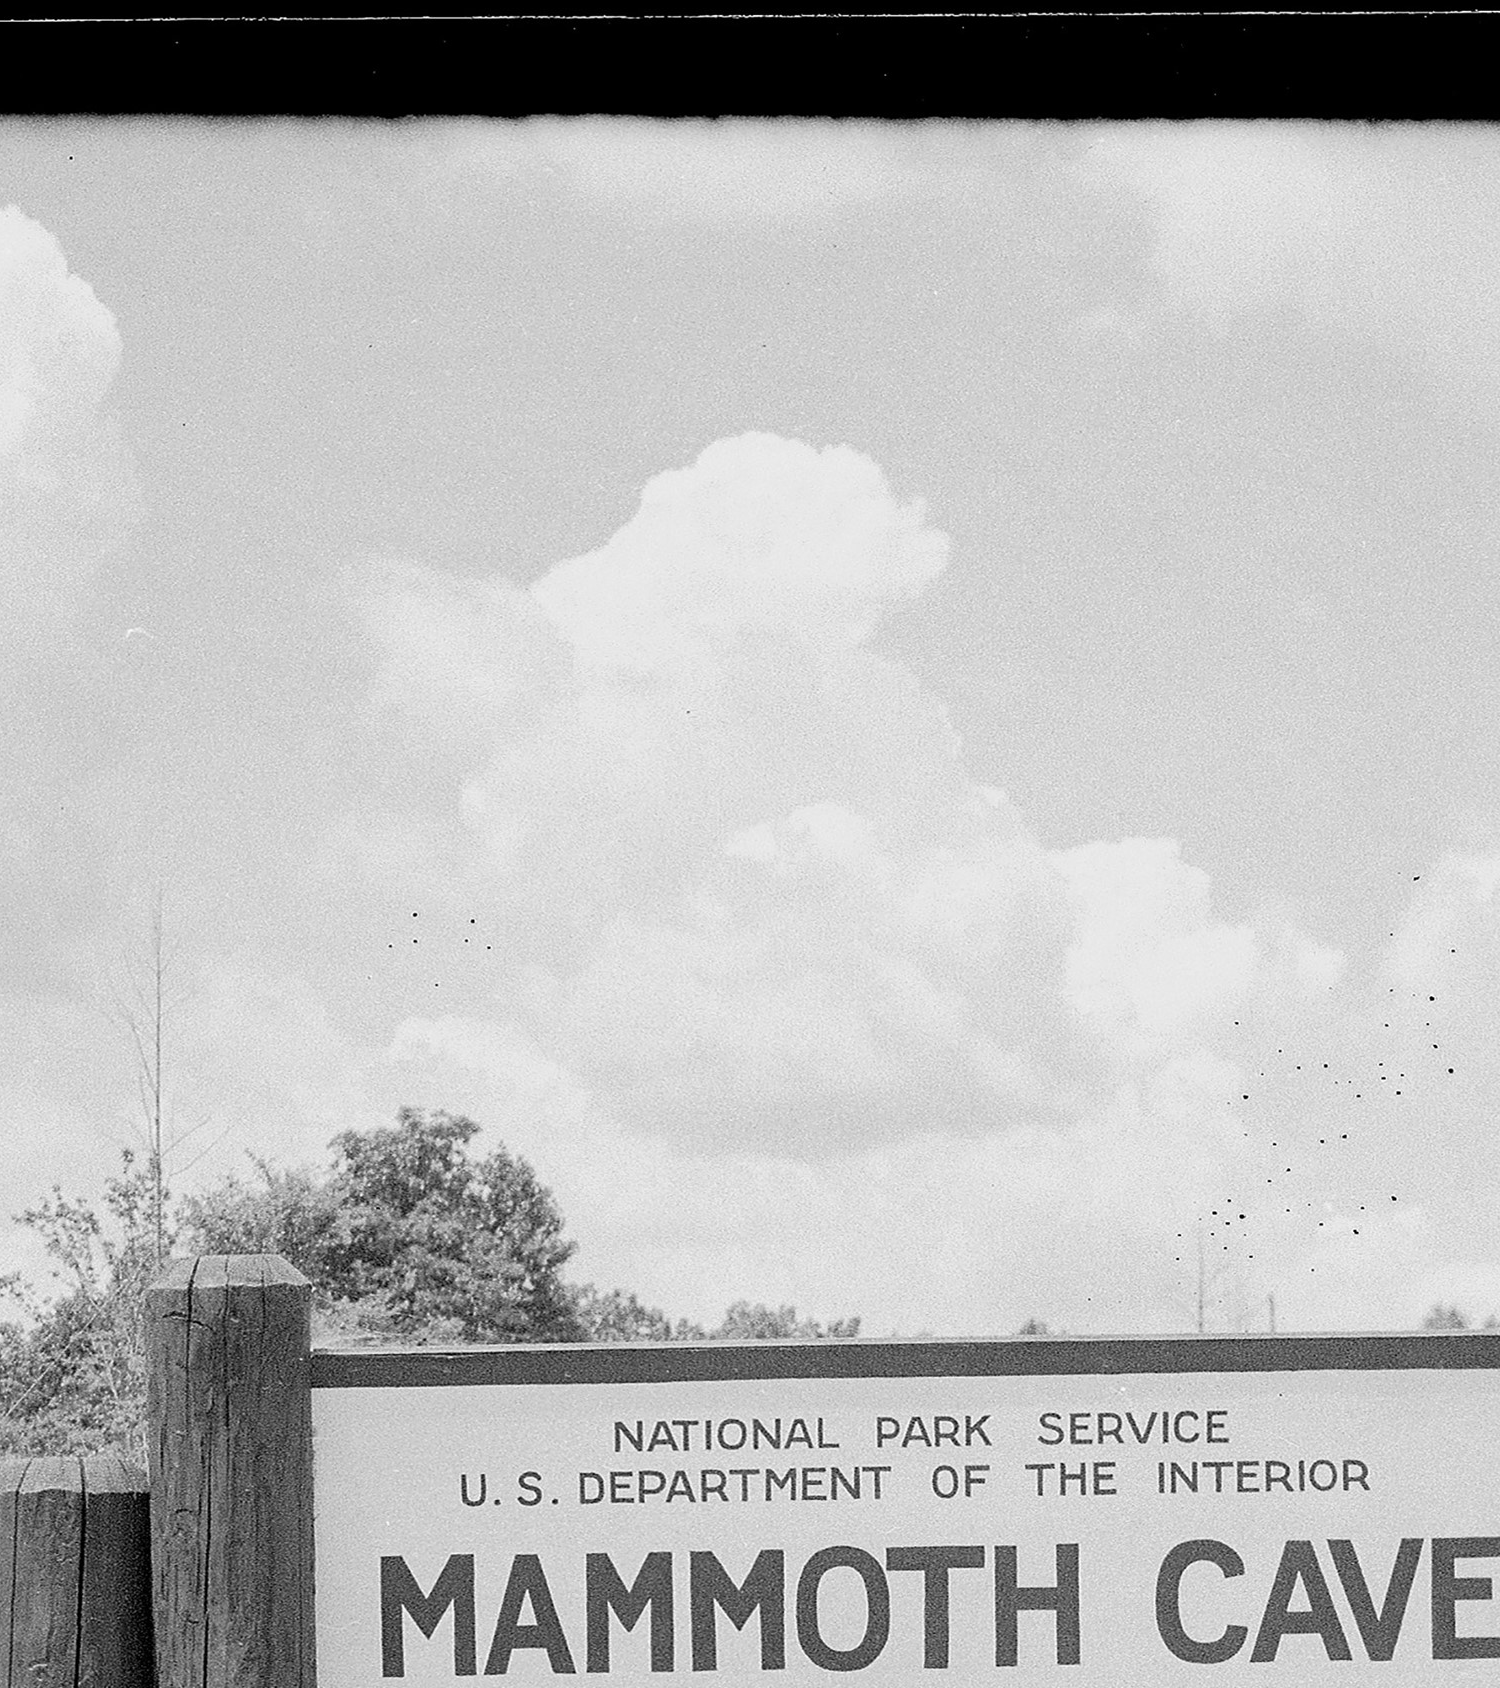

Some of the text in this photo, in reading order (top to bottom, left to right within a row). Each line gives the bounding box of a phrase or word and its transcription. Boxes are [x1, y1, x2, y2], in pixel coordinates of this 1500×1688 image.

[614, 1410, 1230, 1453] NATIONAL PARK SERVICE
[579, 1466, 892, 1505] DEPARTMENT
[931, 1464, 990, 1499] OF
[1024, 1461, 1117, 1497] THE
[1157, 1459, 1370, 1494] INTERIOR
[380, 1542, 1081, 1679] MAMMOTH
